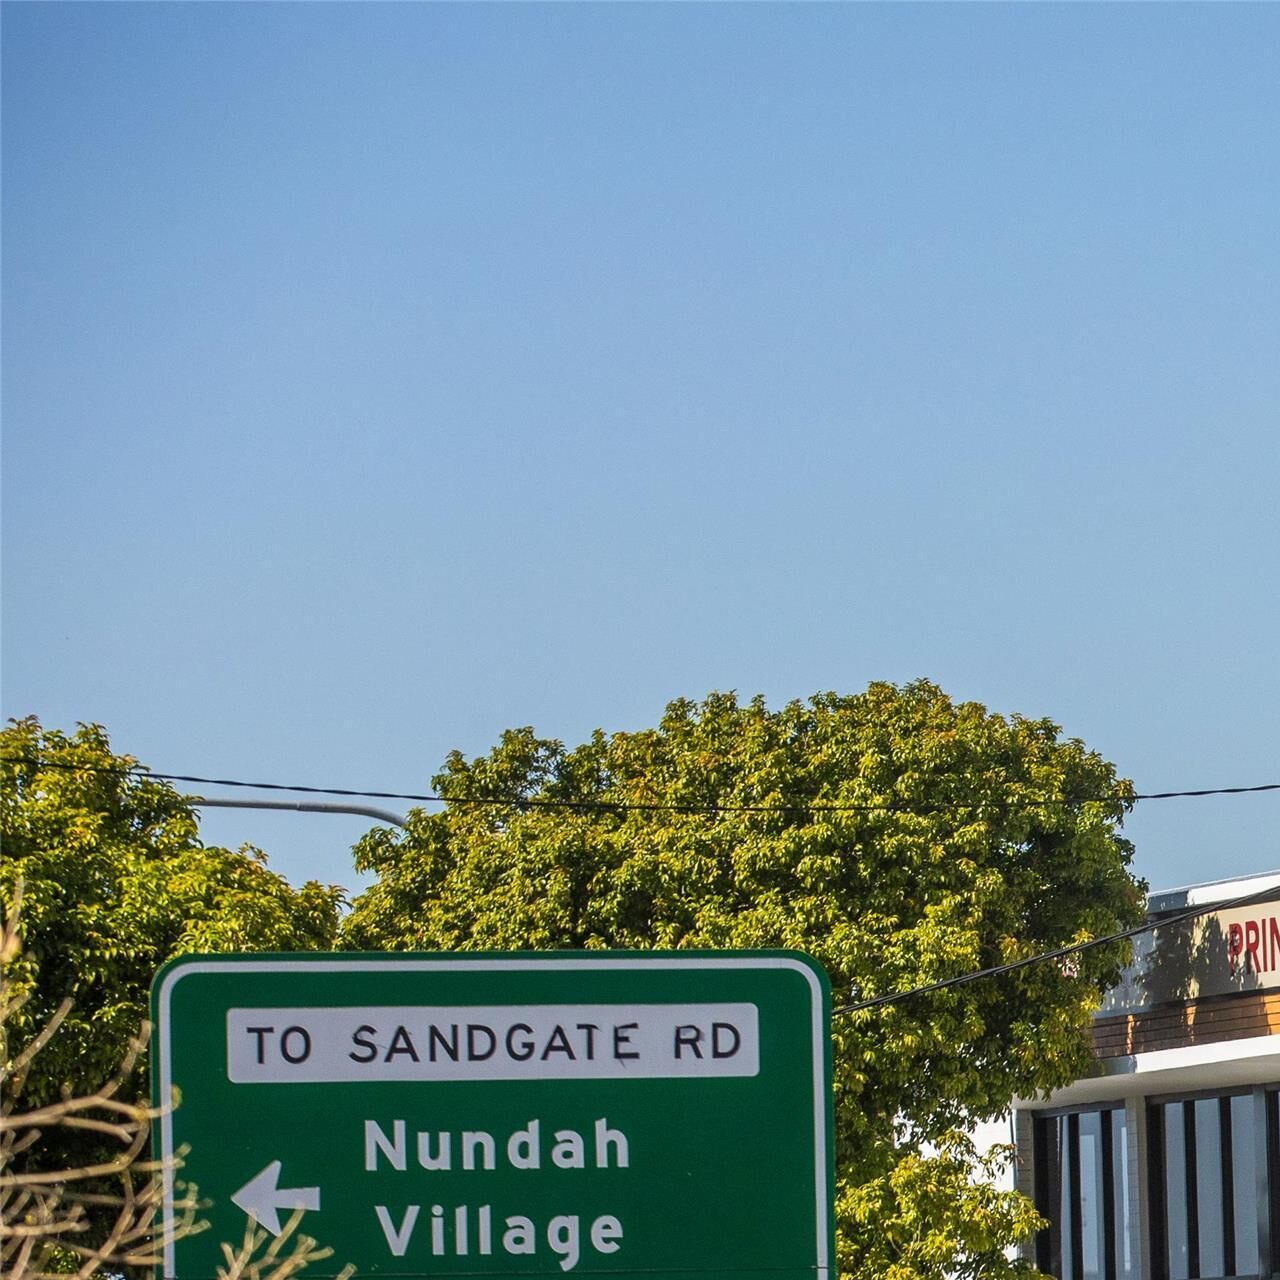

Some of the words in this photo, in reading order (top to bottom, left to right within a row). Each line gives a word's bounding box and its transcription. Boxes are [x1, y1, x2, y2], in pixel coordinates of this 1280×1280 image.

[246, 1026, 312, 1065] TO
[348, 1022, 641, 1063] SANDGATE
[674, 1022, 742, 1060] RD
[364, 1118, 630, 1172] Nundah
[375, 1205, 624, 1272] Village
